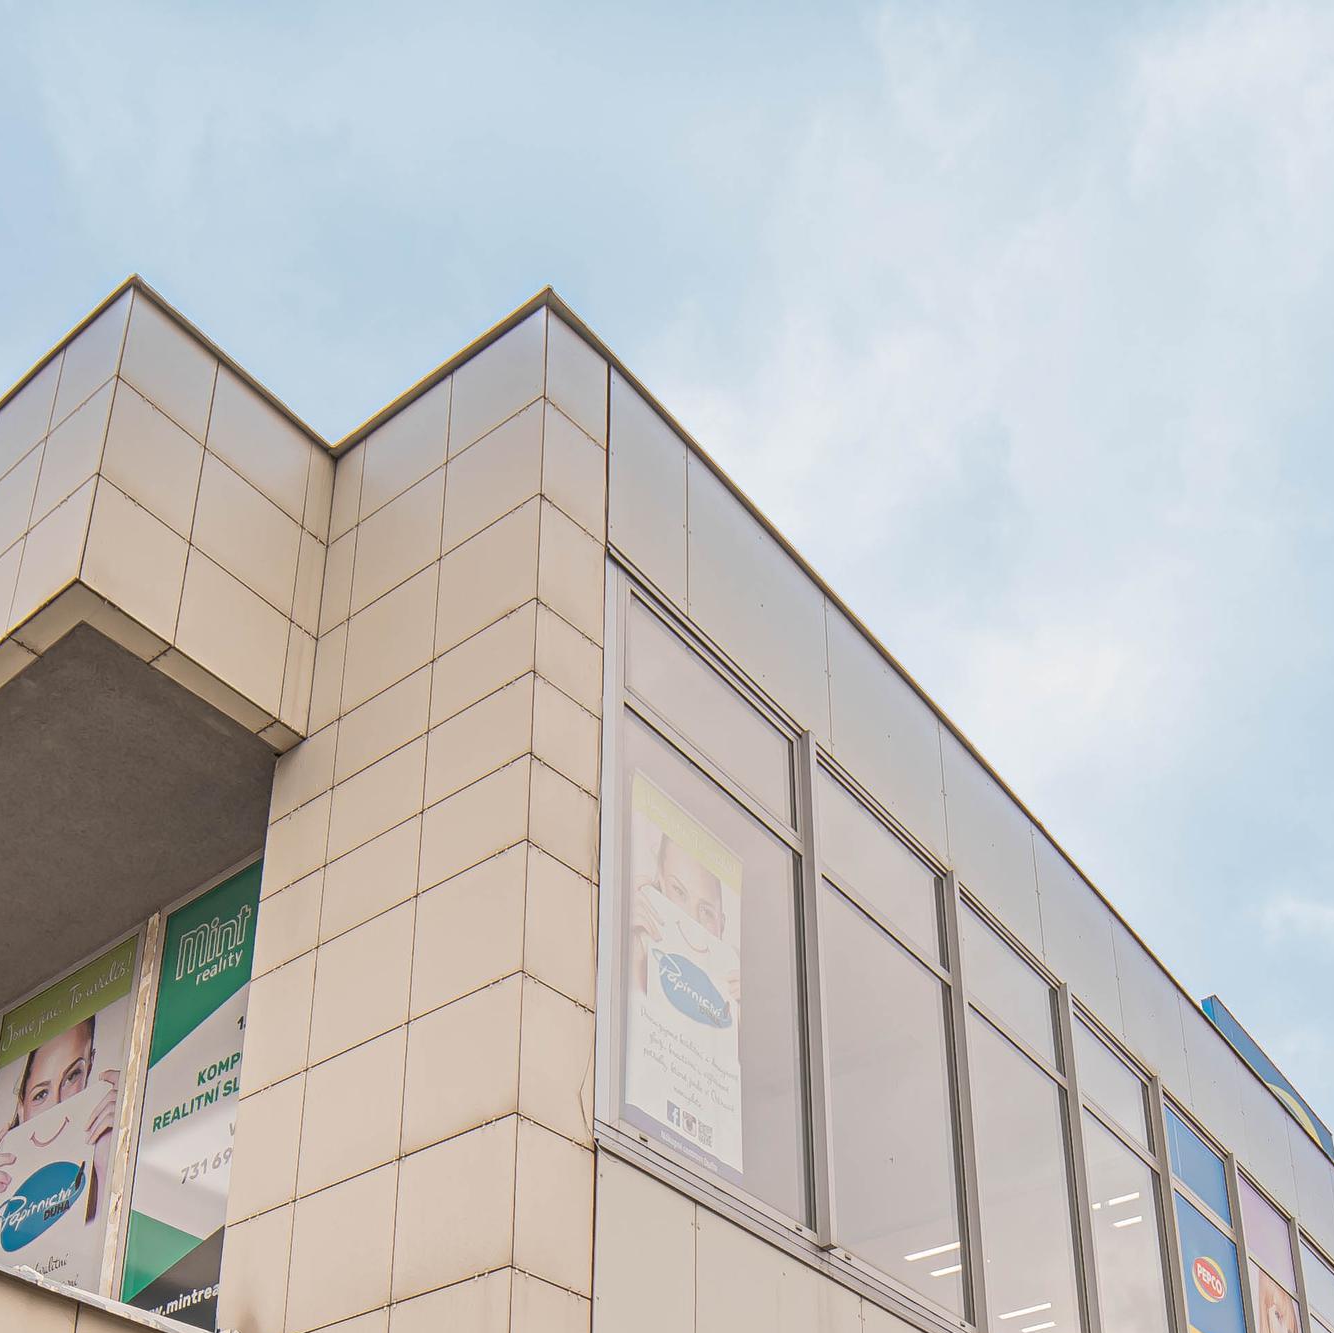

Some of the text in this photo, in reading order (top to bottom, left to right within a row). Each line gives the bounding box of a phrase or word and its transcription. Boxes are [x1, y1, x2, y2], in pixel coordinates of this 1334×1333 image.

[195, 950, 243, 985] reality
[152, 1081, 220, 1133] REALITNÍ
[180, 1157, 208, 1185] 731
[1195, 1263, 1225, 1299] PEPCO
